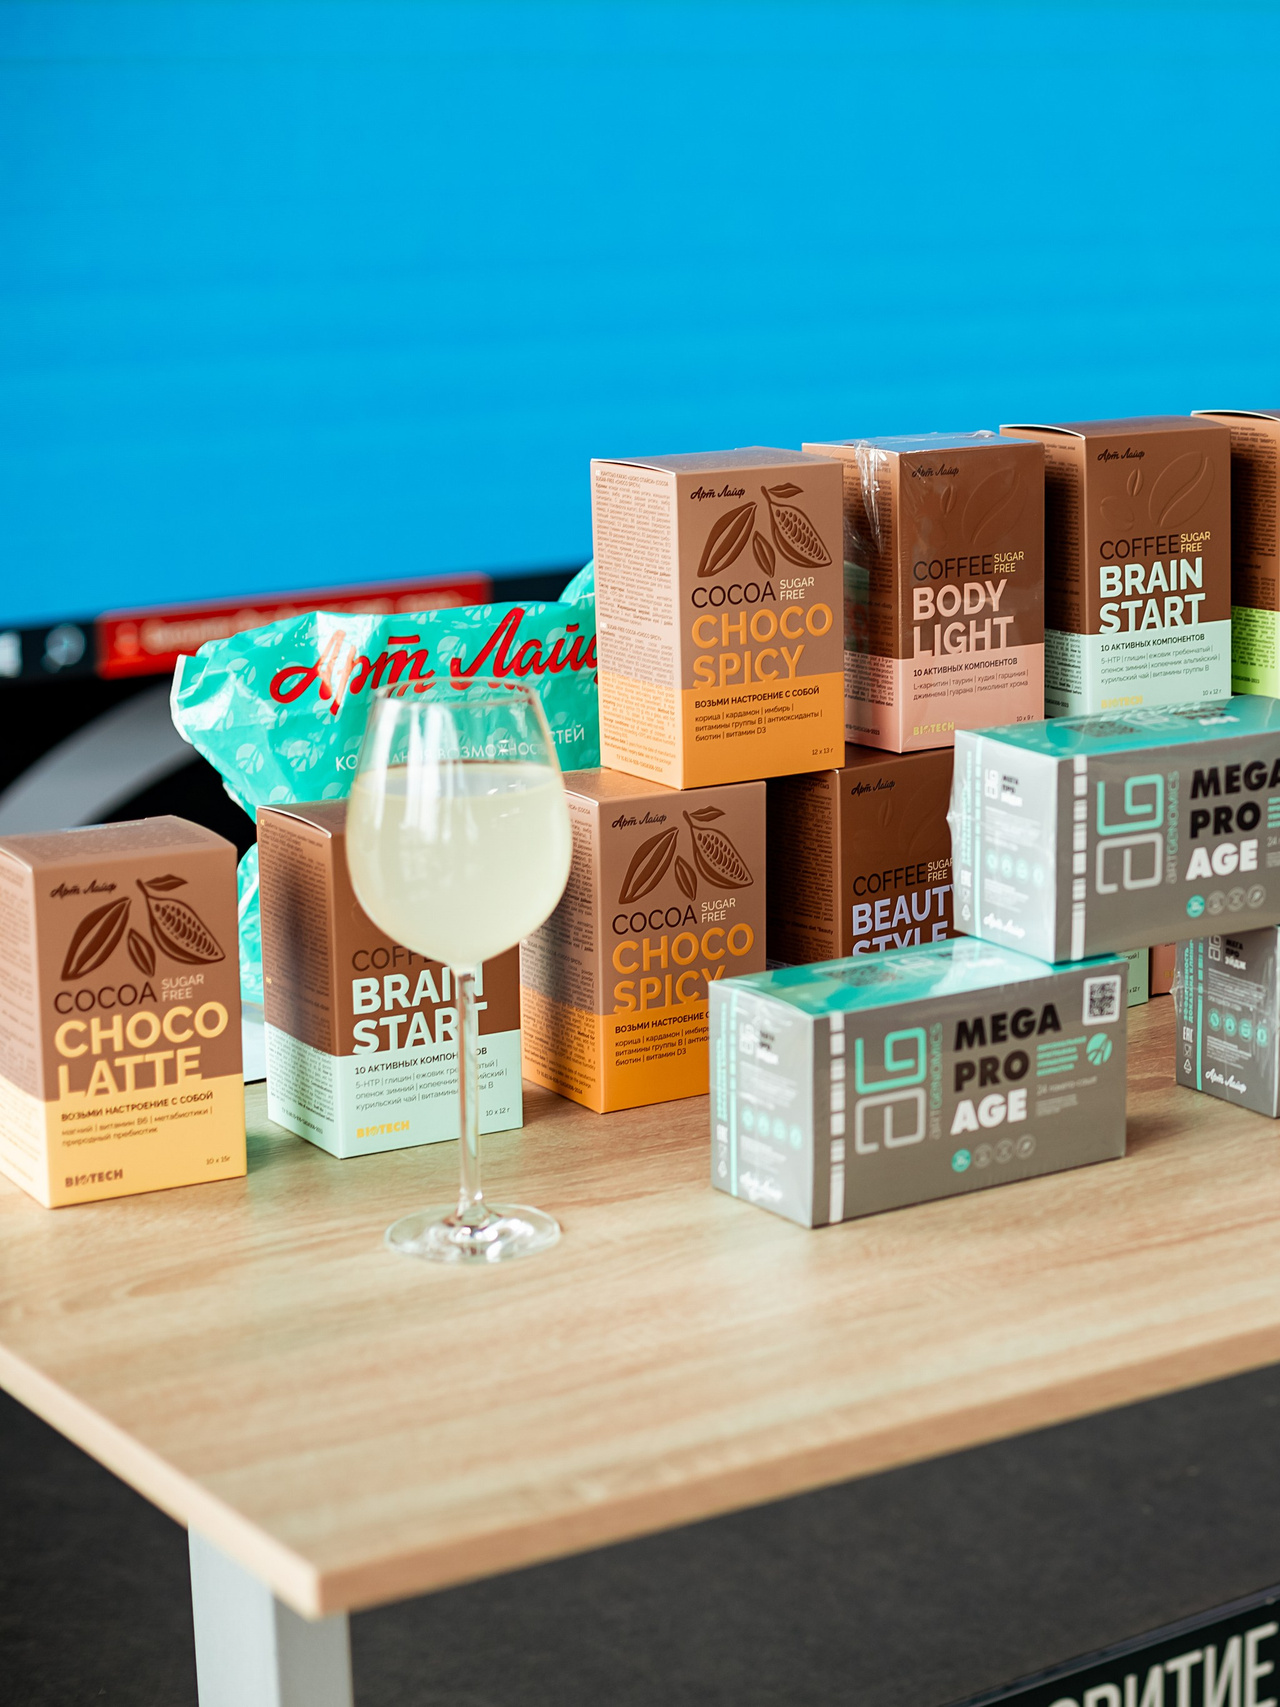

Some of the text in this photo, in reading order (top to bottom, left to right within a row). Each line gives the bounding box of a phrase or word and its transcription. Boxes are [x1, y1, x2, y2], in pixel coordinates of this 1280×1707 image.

[1097, 446, 1145, 462] Арт Лайф
[912, 462, 960, 479] Арт Лайф
[690, 484, 746, 502] Арт Лайф
[1099, 533, 1180, 561] COFFEE
[1180, 530, 1211, 543] SUGAR
[1180, 541, 1203, 553] FREE
[913, 554, 993, 582] COFFEE
[993, 551, 1025, 564] SUGAR
[993, 562, 1017, 574] FREE
[779, 576, 815, 590] SUGAR
[1099, 556, 1203, 599] BRAIN
[691, 580, 777, 608] COCOA
[779, 588, 806, 601] FREE
[913, 578, 1007, 621] BODY
[1099, 591, 1207, 635] START
[691, 602, 834, 649] CHOCO
[913, 615, 1014, 659] LIGHT
[1100, 633, 1205, 652] 10 АКТИВНЫХ КОМПОНЕНТОВ
[268, 629, 437, 717] Арт
[693, 644, 805, 690] SPICY
[913, 657, 1018, 677] 10 АКТИВНЫХ КОМПОНЕНТОВ
[695, 685, 820, 709] ВОЗЬМИ НАСТРОЕНИЕ С СОБОЙ
[695, 703, 791, 724] корица кардамон имбирь
[695, 710, 819, 732] витамины группы антиоксиданты
[695, 727, 767, 742] биотин витамин D3
[850, 778, 896, 797] Арт Лайф
[612, 811, 668, 830] Арт Лайф
[1189, 801, 1262, 839] PRO
[1185, 839, 1259, 882] AGE
[852, 862, 927, 897] COFFEE
[927, 870, 948, 882] FREE
[50, 879, 118, 899] Арт Лайф
[701, 897, 737, 913] SUGAR
[852, 883, 954, 937] BEAUT
[612, 903, 698, 935] COCOA
[701, 910, 727, 924] FREE
[612, 922, 755, 975] CHOCO
[161, 974, 204, 990] SUGAR
[613, 964, 727, 1014] SPICY
[54, 982, 158, 1015] COCOA
[162, 987, 193, 1002] FREE
[54, 1001, 229, 1058] CHOCO
[615, 1012, 704, 1034] ВОЗЬМИ НАСТРОЕНИЕ
[954, 1003, 1062, 1052] MEGA
[615, 1030, 680, 1048] корица кардамон
[615, 1040, 677, 1057] витамины группы
[355, 1047, 488, 1075] 10 АКТИВНЫХ КОМПОНОВ
[615, 1047, 687, 1067] биотин витамин D3
[58, 1046, 202, 1100] LATTE
[954, 1050, 1030, 1092] PRO
[61, 1090, 214, 1122] ВОЗЬМИ НАСТРОЕНИЕ СОБОЙ
[950, 1088, 1028, 1135] AGE
